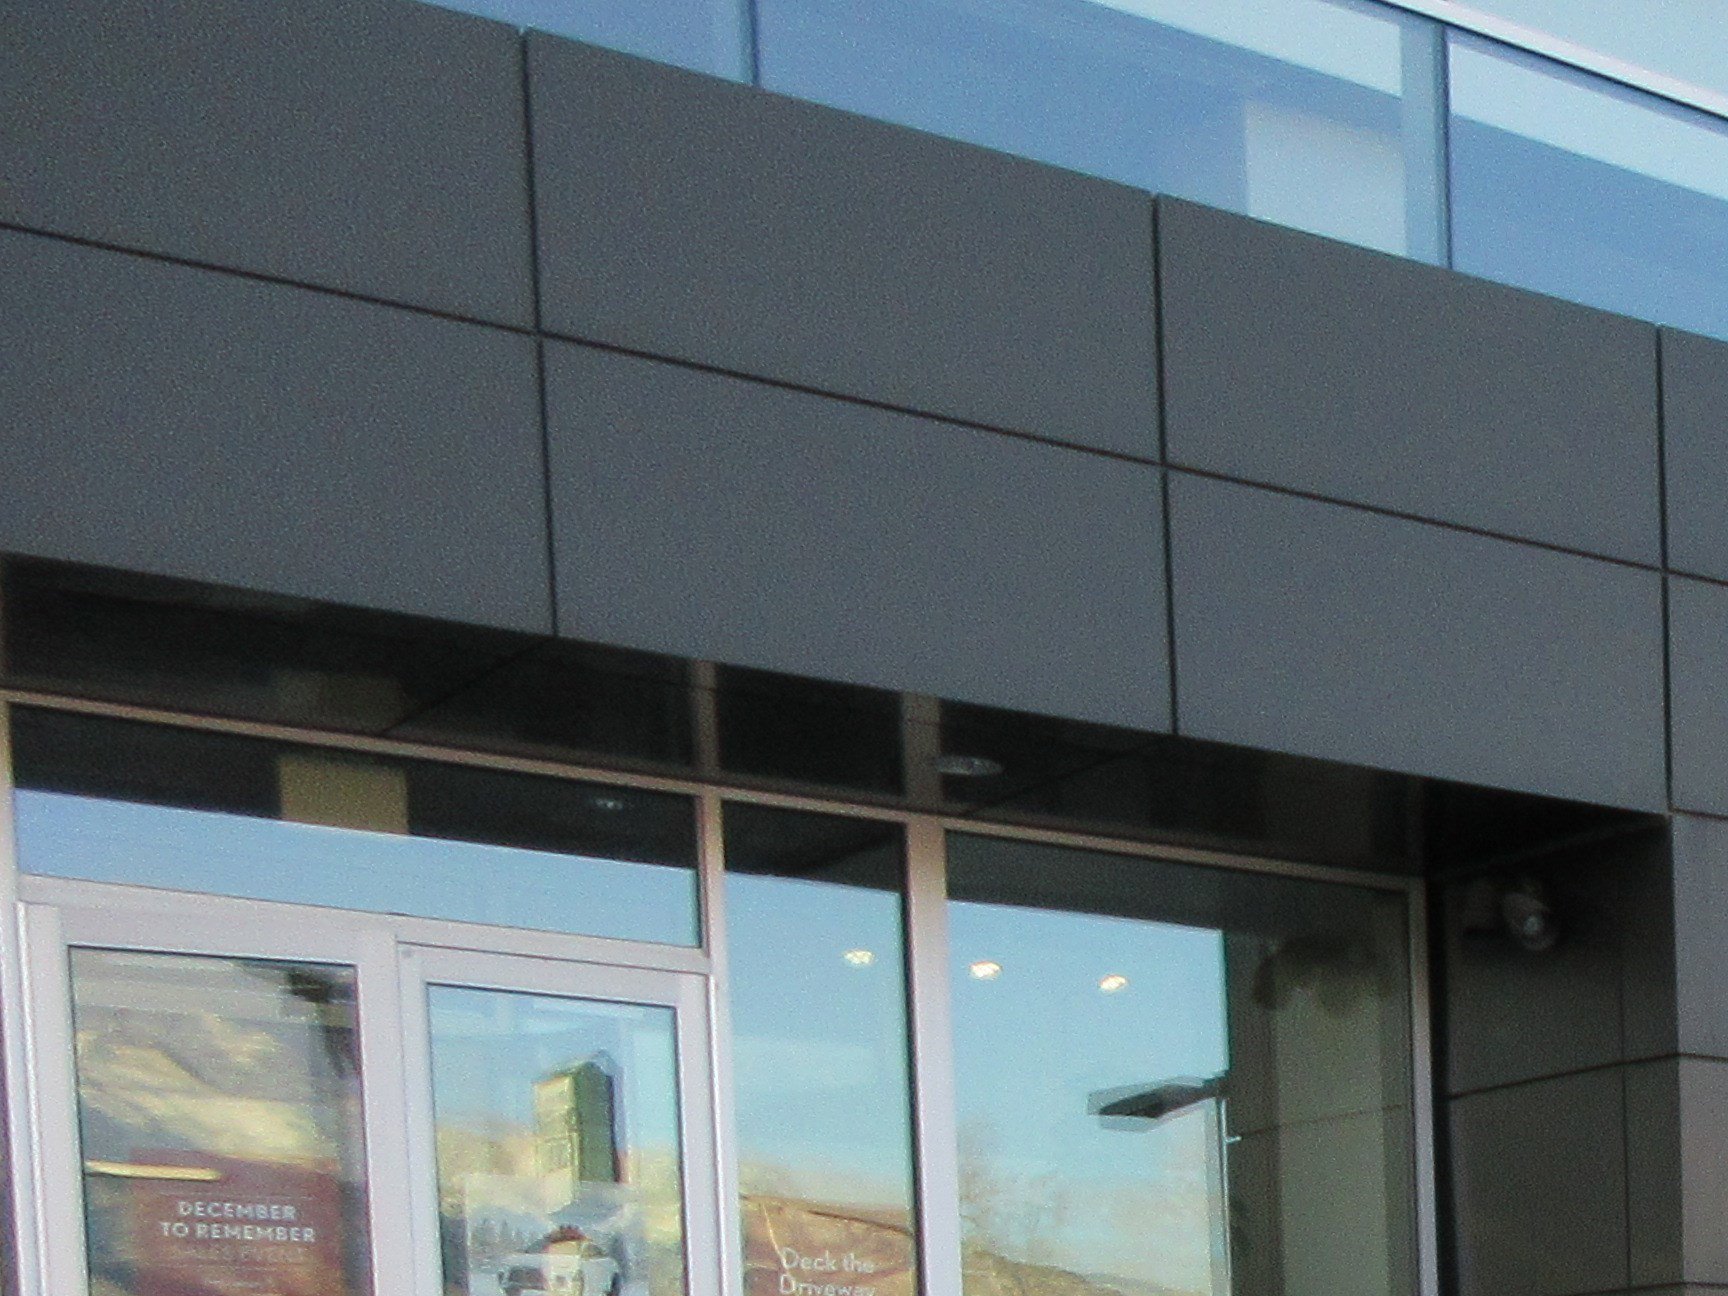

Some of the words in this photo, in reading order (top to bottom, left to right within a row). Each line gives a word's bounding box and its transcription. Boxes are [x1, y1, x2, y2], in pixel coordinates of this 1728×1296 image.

[177, 1200, 297, 1221] DECEMBER
[159, 1220, 190, 1238] TO
[195, 1222, 316, 1243] REMEMBER
[781, 1247, 837, 1271] Deck
[842, 1252, 875, 1274] the
